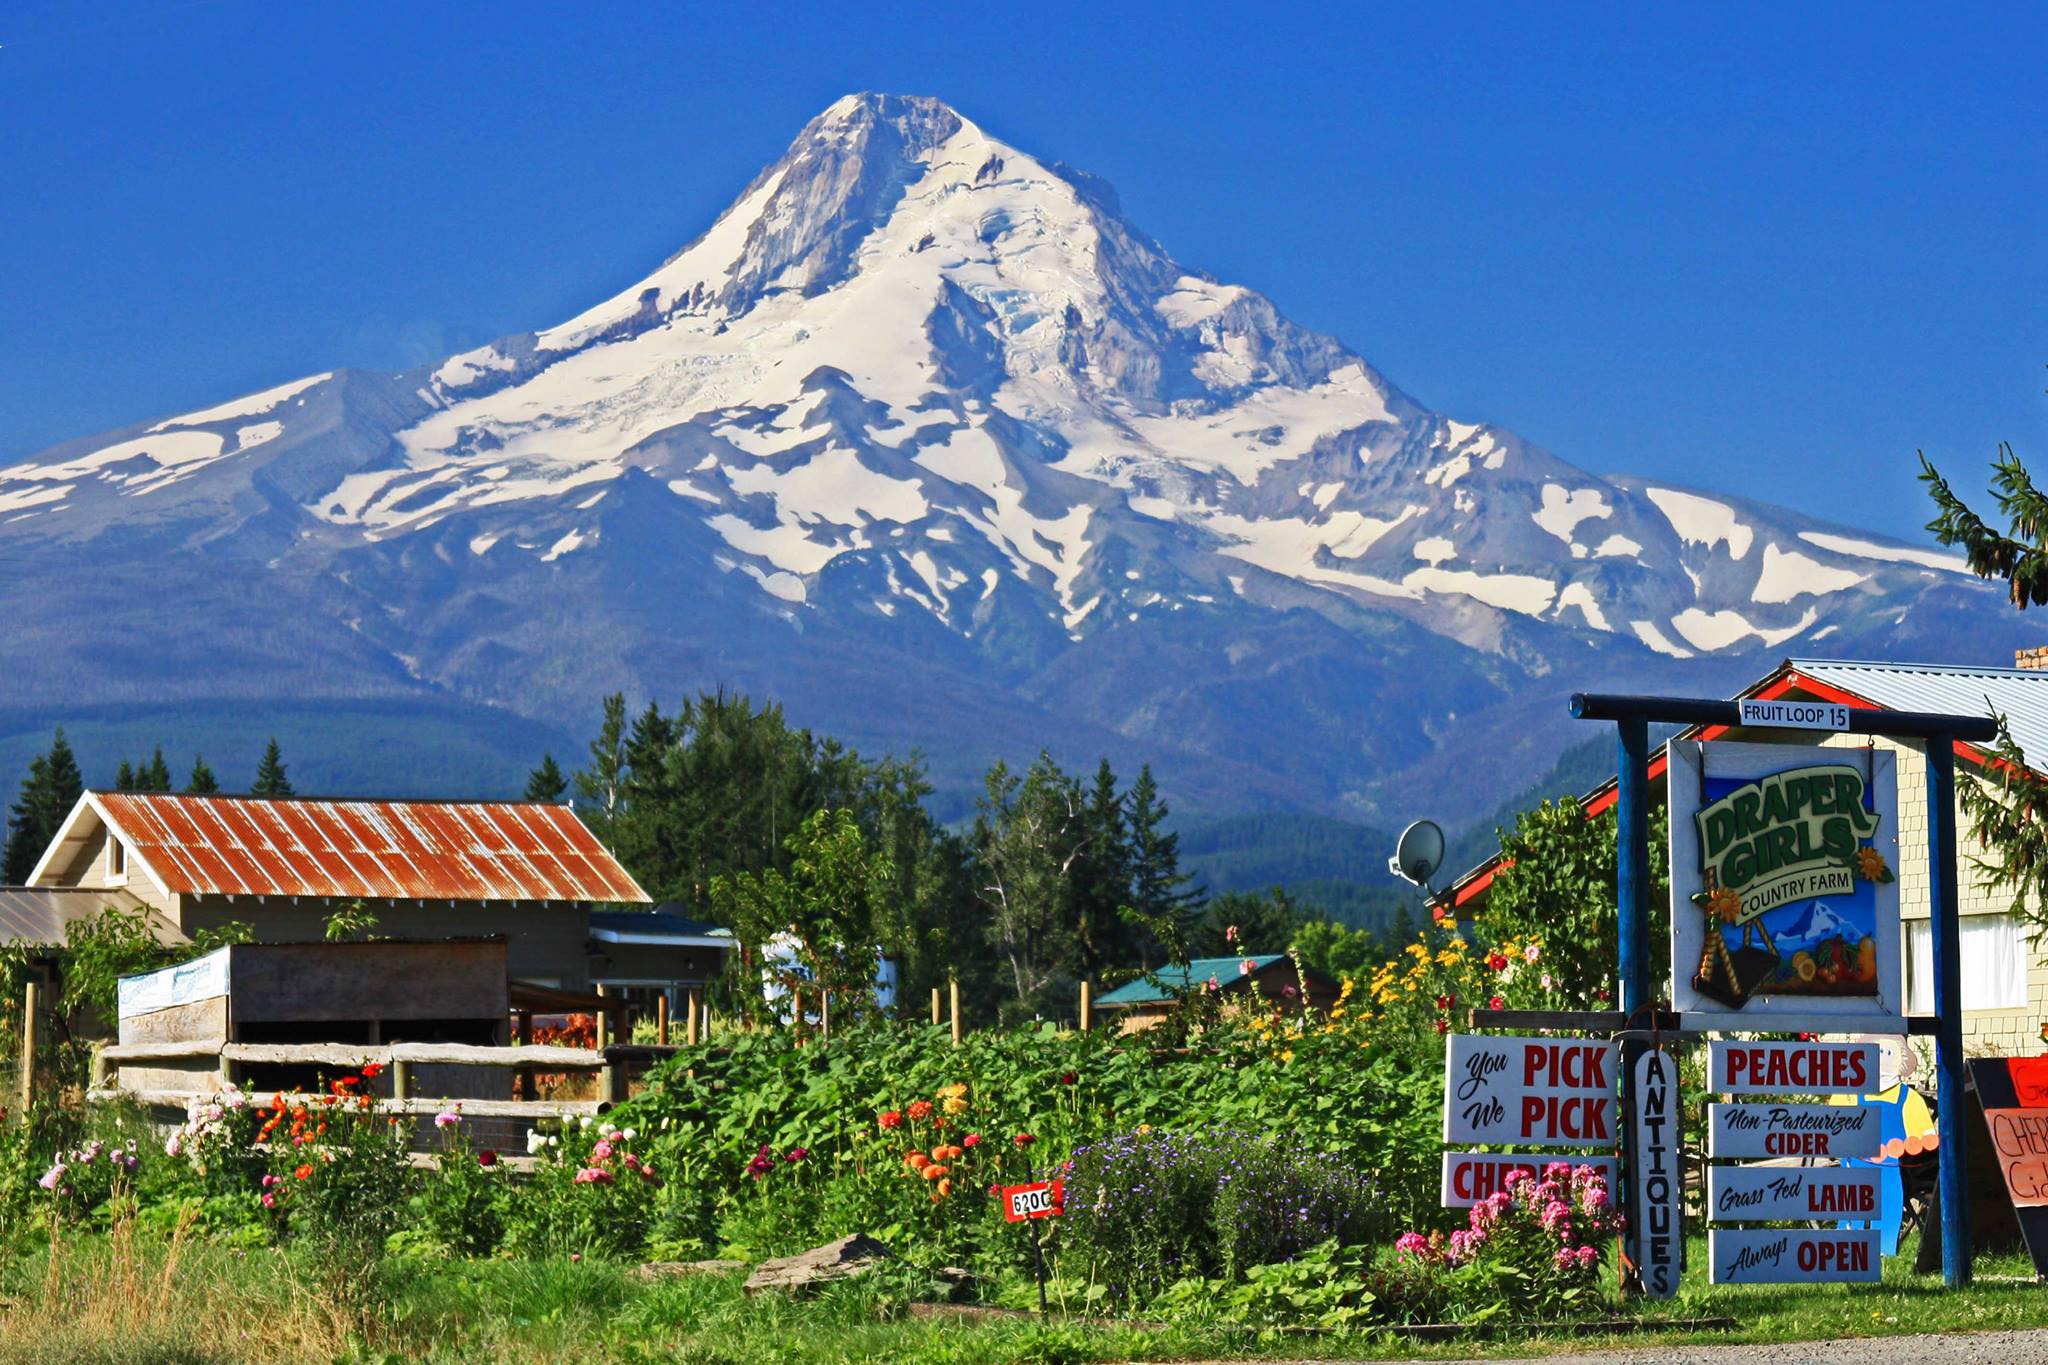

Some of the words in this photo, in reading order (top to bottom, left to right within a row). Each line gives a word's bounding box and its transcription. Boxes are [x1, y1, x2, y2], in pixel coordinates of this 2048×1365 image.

[1744, 705, 1783, 721] FRUIT
[1786, 707, 1824, 723] LOOP
[1829, 708, 1846, 726] 15
[1705, 774, 1872, 859] DRAPER
[1720, 816, 1857, 889] GIRLS
[1740, 878, 1806, 917] COUNTRY
[1809, 872, 1850, 891] FARM
[1457, 1051, 1508, 1100] You
[1523, 1045, 1608, 1089] PICK
[1726, 1048, 1867, 1087] PEACHES
[1462, 1096, 1506, 1130] We
[1520, 1096, 1609, 1139] PICK
[1765, 1132, 1829, 1155] CIDER
[1644, 1056, 1671, 1294] ANTIQUES
[1719, 1186, 1766, 1212] Grass
[1767, 1174, 1803, 1202] Fed
[1808, 1184, 1875, 1212] LAMB
[1725, 1237, 1788, 1280] Always
[1797, 1240, 1869, 1272] OPEN
